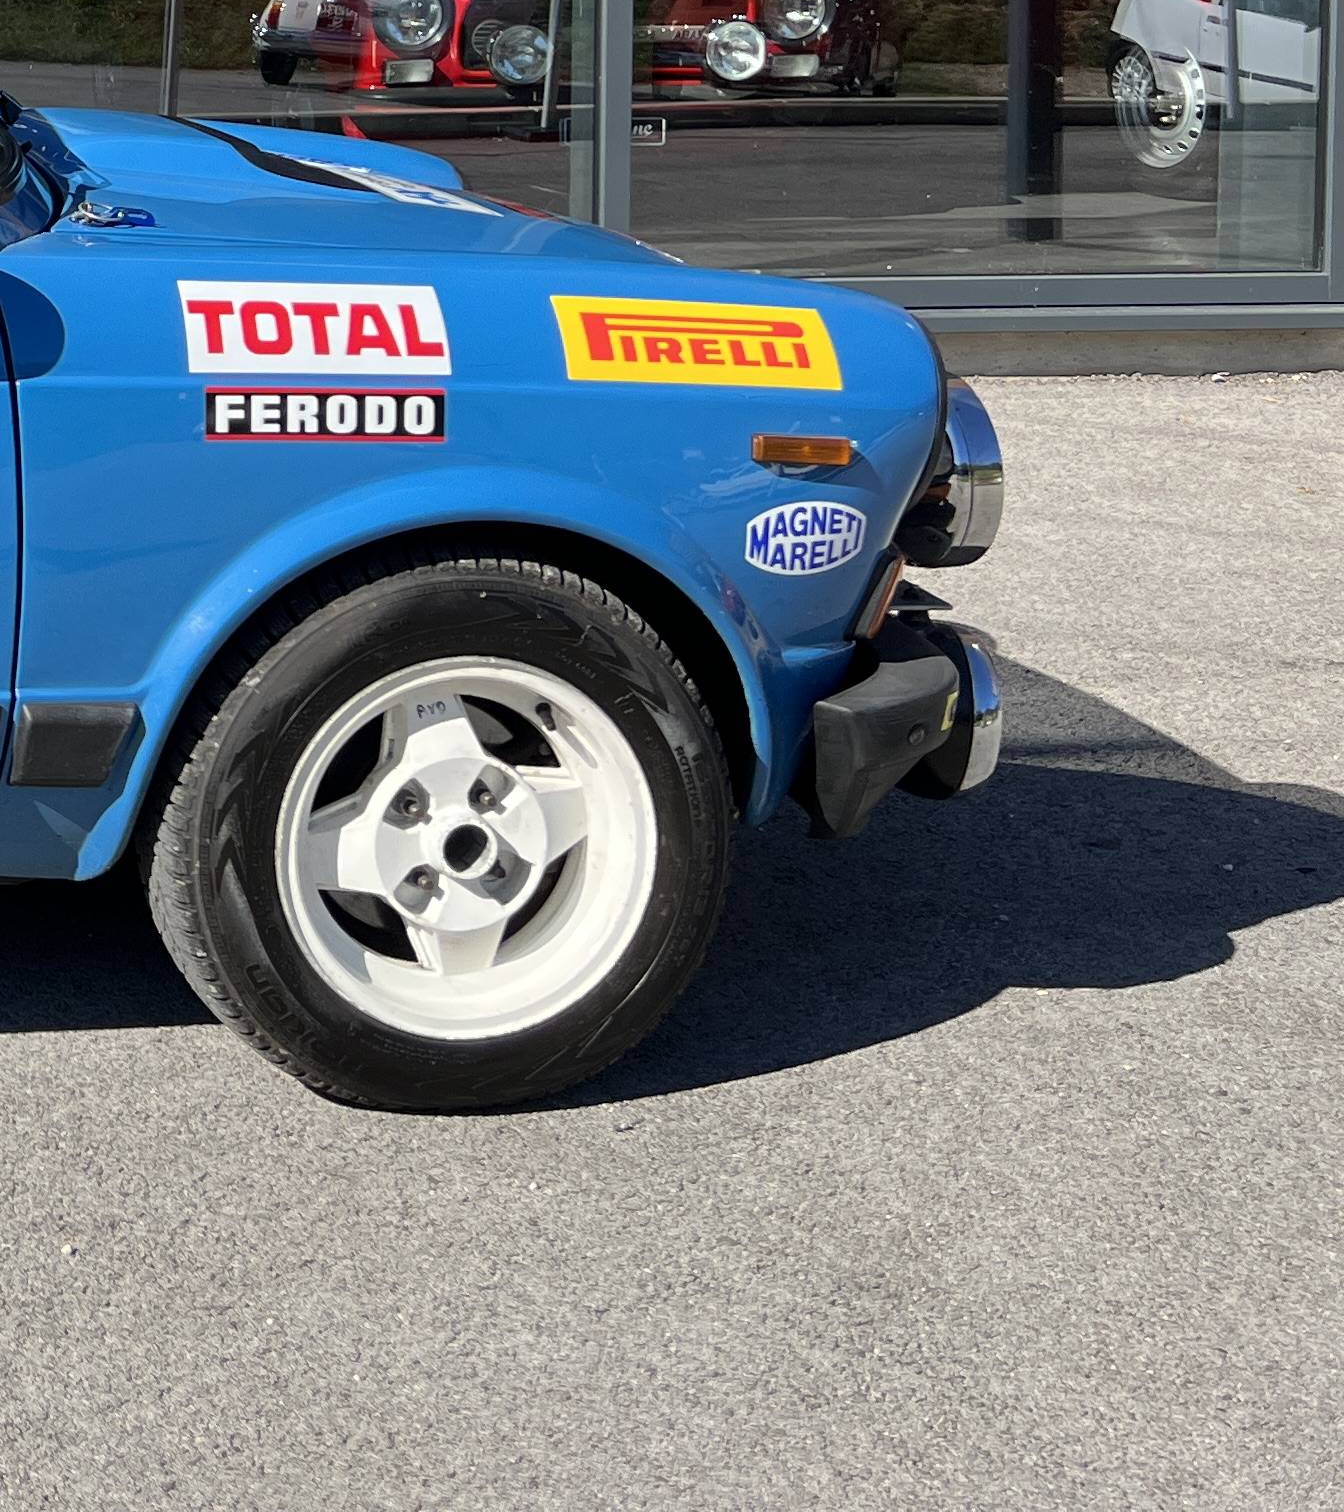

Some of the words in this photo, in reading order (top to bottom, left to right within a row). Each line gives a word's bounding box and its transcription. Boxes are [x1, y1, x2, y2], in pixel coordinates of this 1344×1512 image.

[187, 299, 444, 358] TOTAL
[579, 311, 811, 369] PIRELLI
[214, 393, 436, 434] FERODO
[750, 506, 864, 548] MAGNETI
[750, 534, 864, 570] MARELLI
